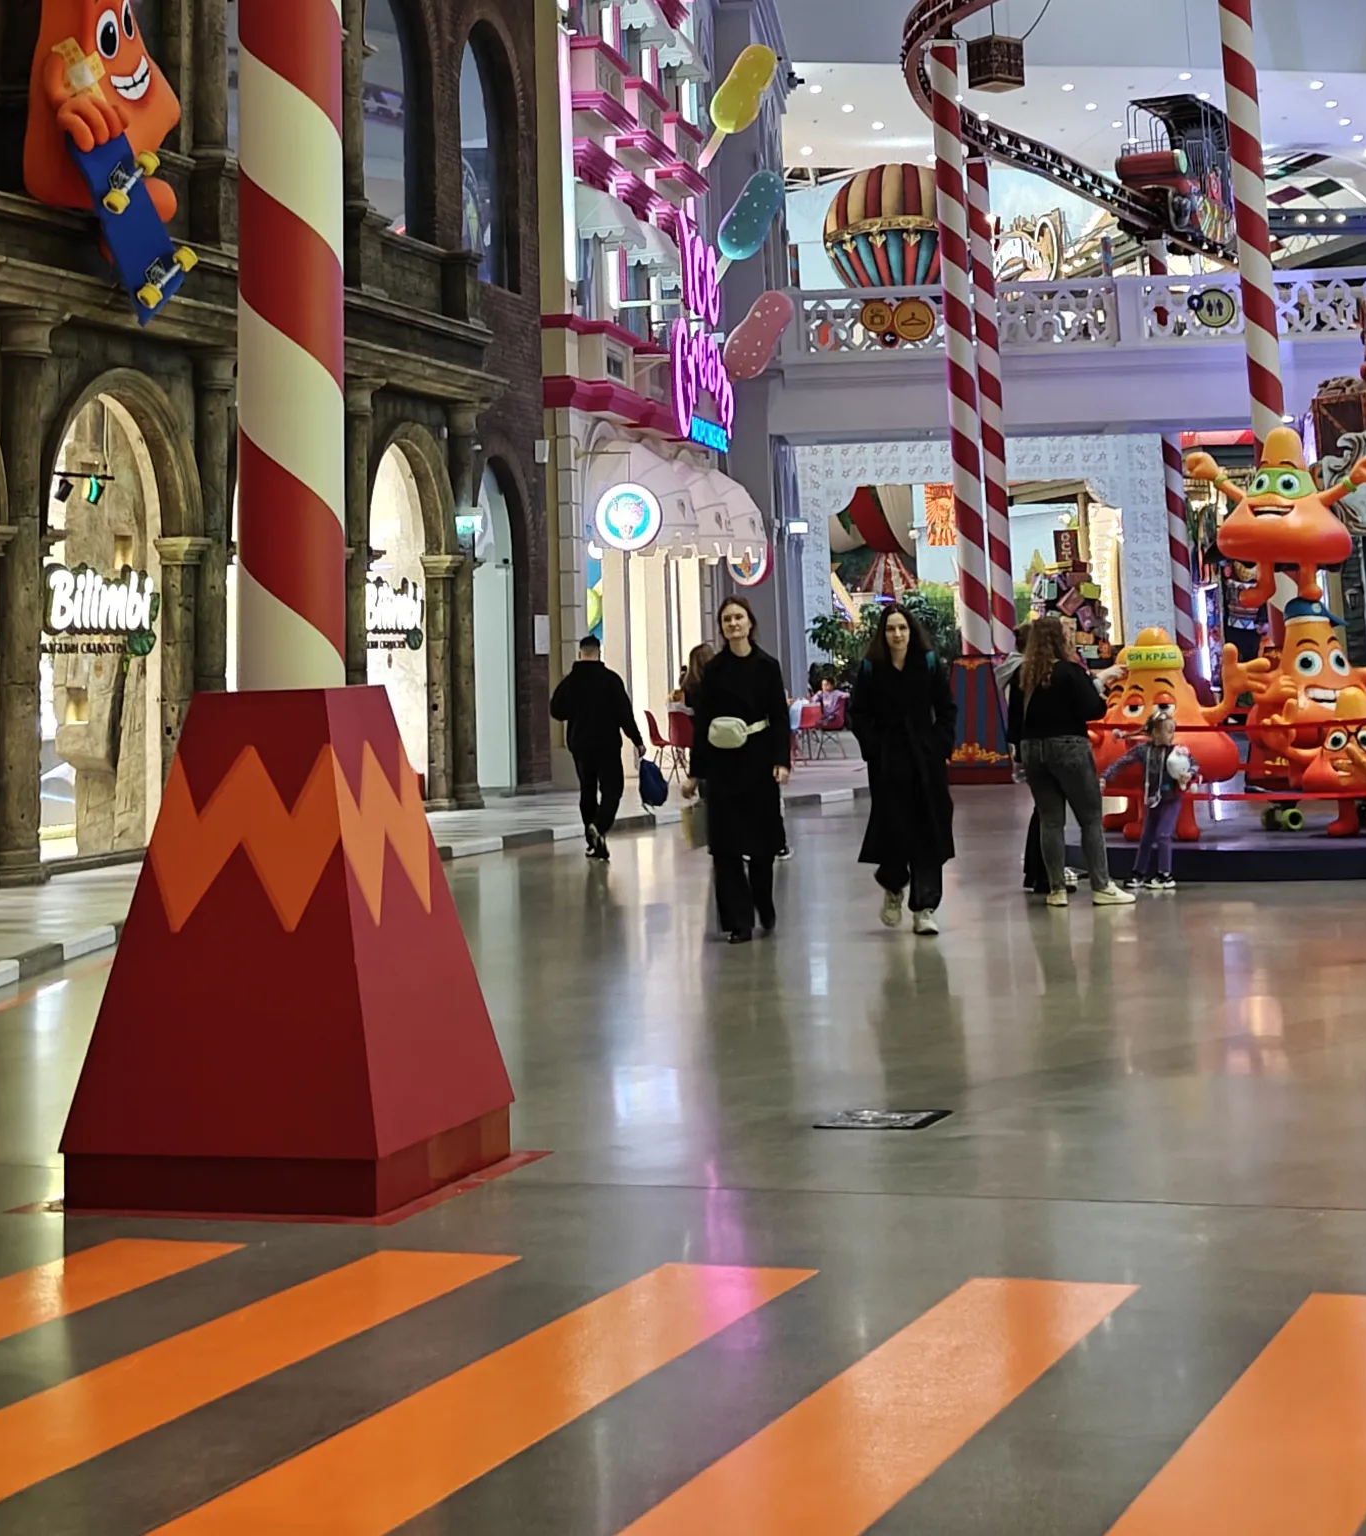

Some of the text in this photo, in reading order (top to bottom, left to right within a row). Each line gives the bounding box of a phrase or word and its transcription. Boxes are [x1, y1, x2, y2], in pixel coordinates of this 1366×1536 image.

[678, 208, 720, 327] Ice
[674, 317, 734, 440] Cream
[49, 568, 155, 631] Bilimbi
